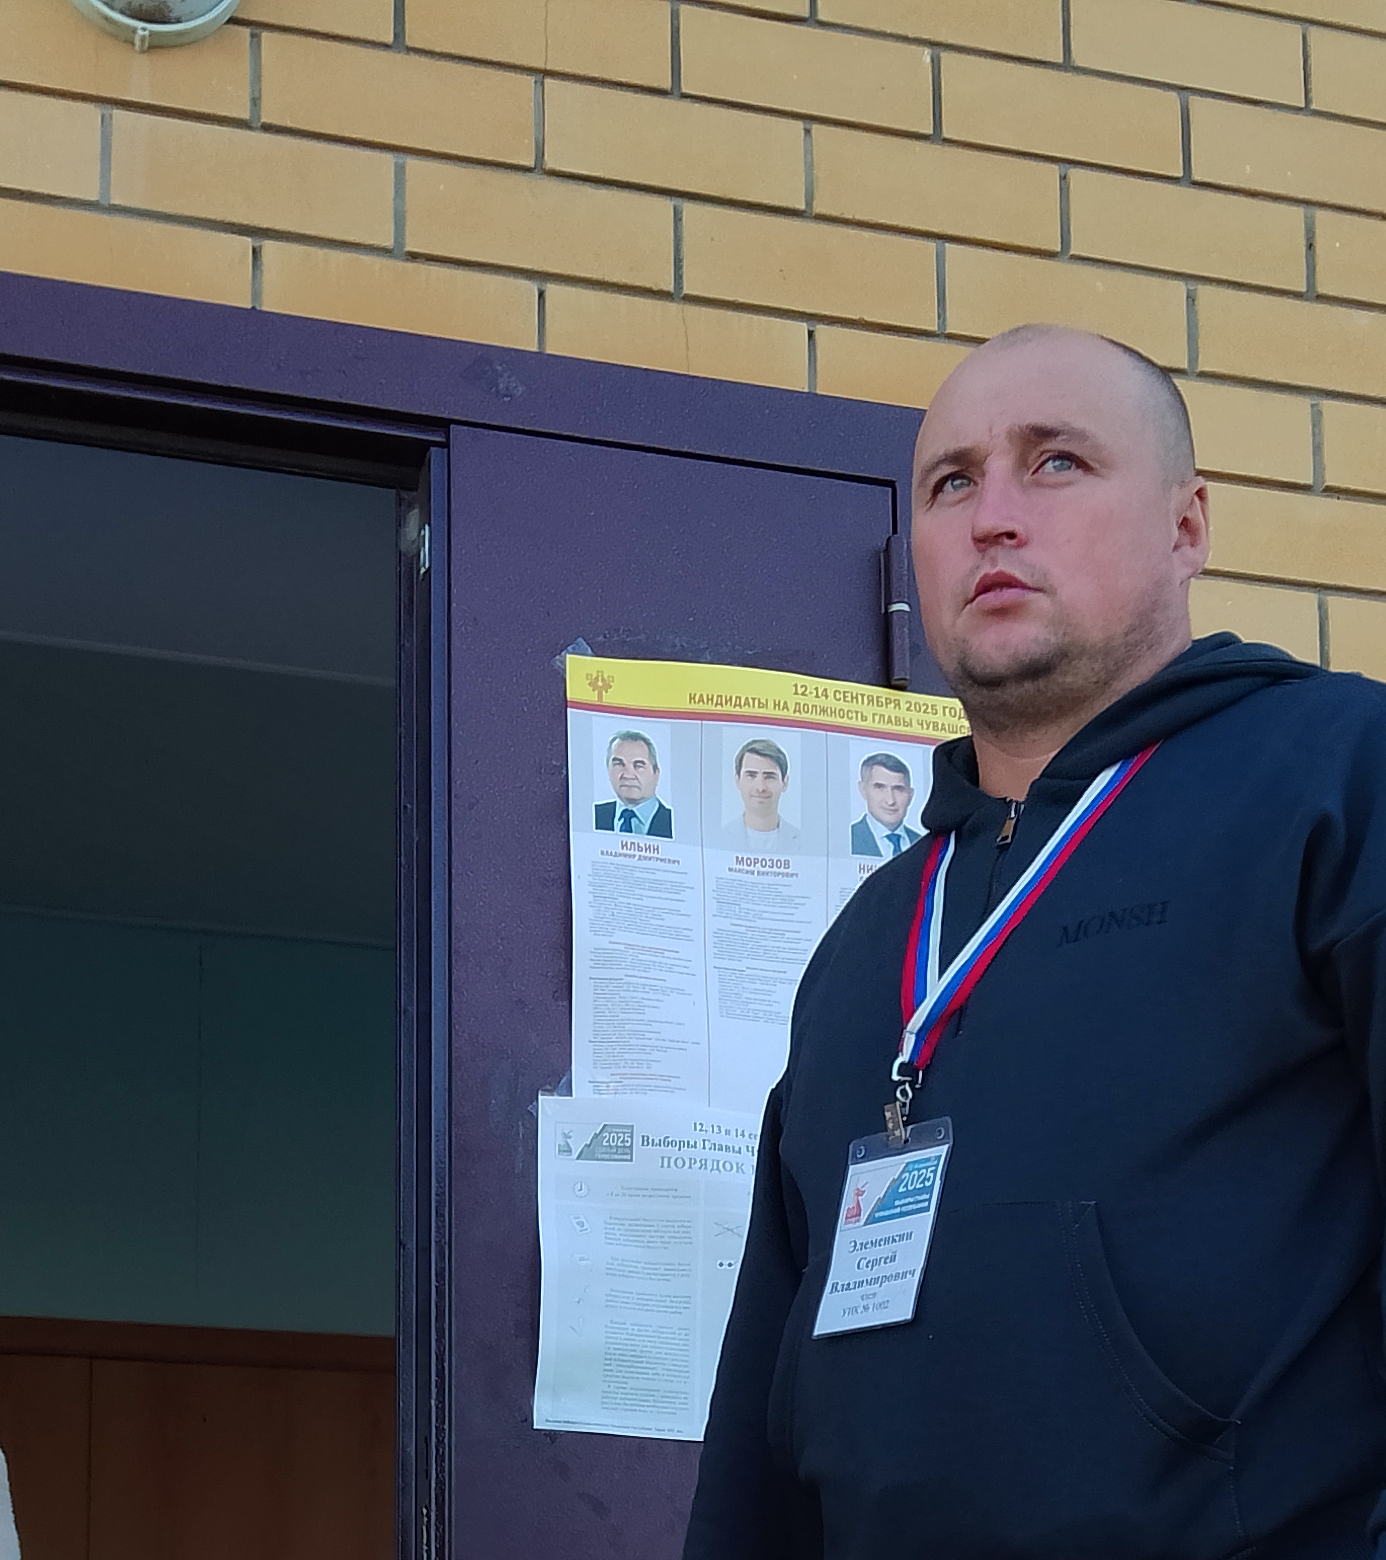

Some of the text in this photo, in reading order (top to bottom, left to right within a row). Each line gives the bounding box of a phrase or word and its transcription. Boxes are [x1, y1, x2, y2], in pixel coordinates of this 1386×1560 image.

[792, 683, 967, 721] 12-14 СЕНТЯБРЯ 2025 ГОД
[688, 692, 971, 736] КАНДИДАТЫ НА ДОЛЖНОСТЬ ГЛАВЫ ЧУВАШС
[619, 840, 661, 856] ИЛЬИН
[735, 855, 792, 870] МОРОЗОВ
[602, 1132, 631, 1147] 2025
[710, 1124, 722, 1135] 13
[734, 1128, 746, 1138] 14
[641, 1134, 698, 1151] Выборы
[701, 1138, 742, 1155] Главы
[659, 1156, 746, 1175] ПОРЯДОК
[898, 1166, 936, 1193] 2025
[856, 1250, 898, 1271] Сергей
[828, 1268, 917, 1295] Владимирович
